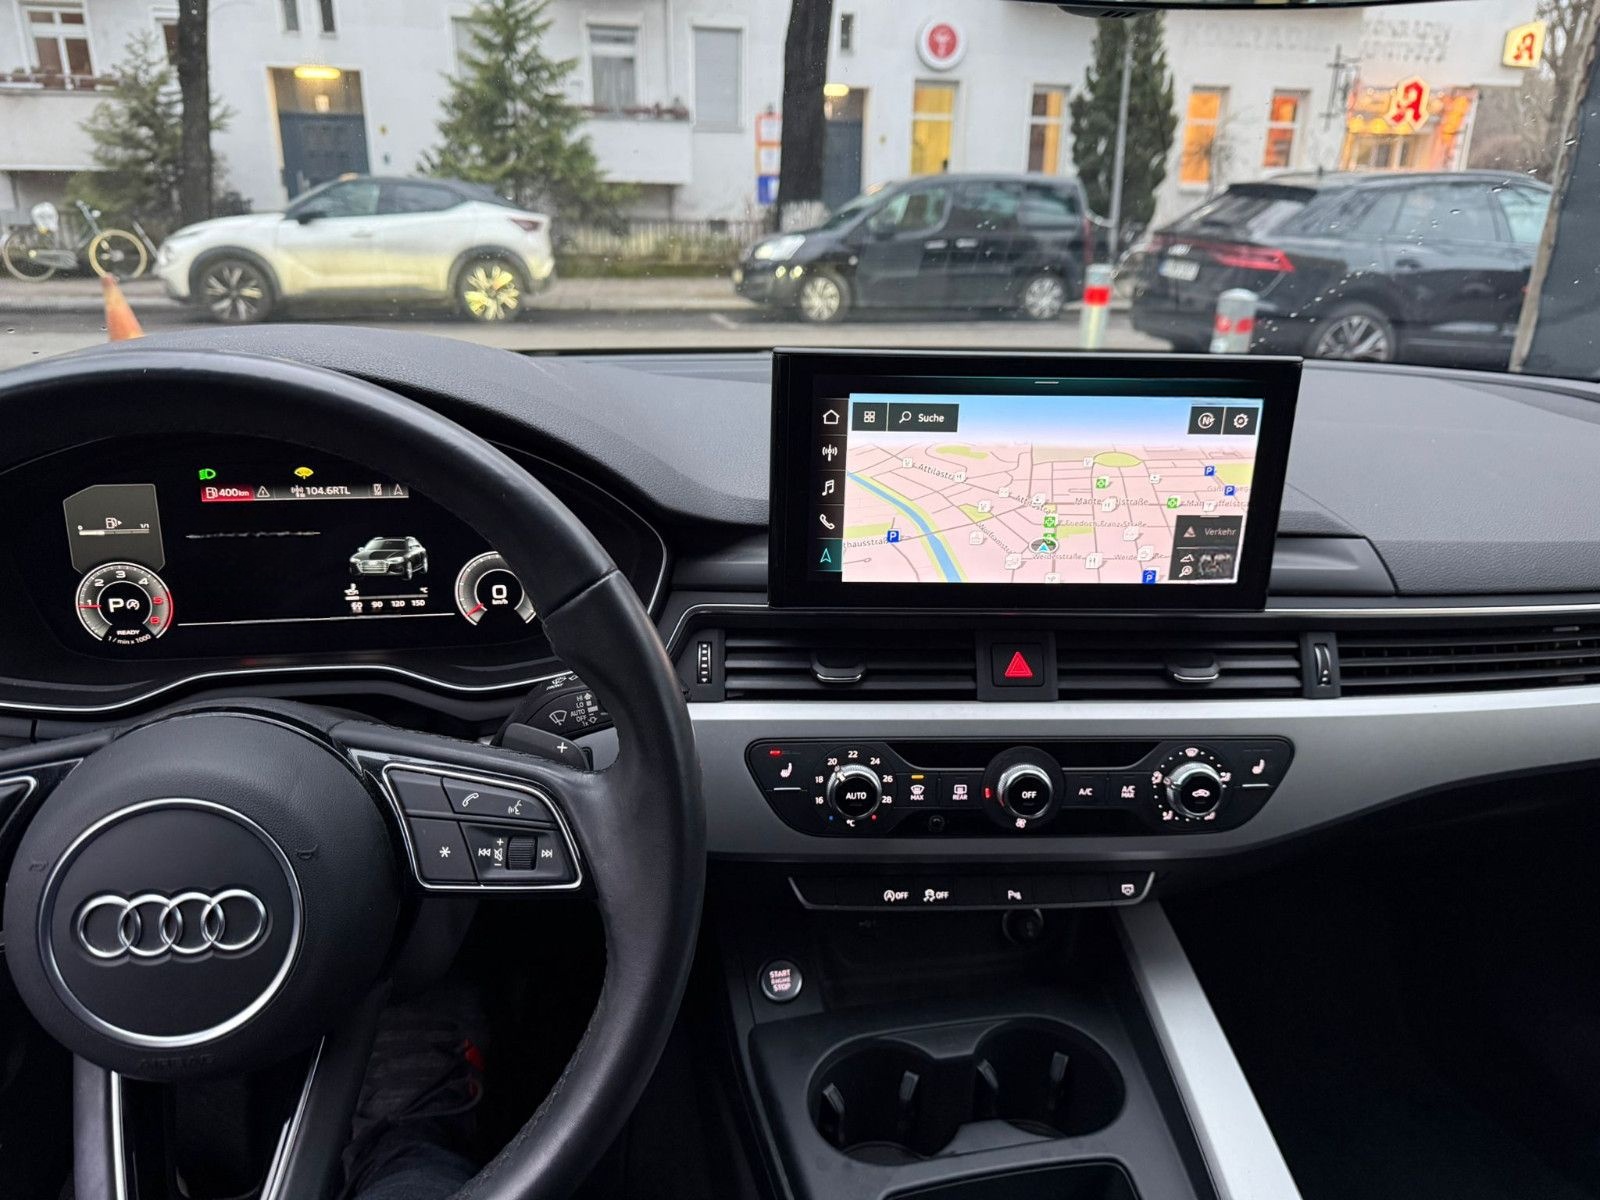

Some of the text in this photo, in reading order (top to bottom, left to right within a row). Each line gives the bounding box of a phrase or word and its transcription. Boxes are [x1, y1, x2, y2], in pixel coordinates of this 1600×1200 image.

[1392, 81, 1424, 122] A
[918, 413, 944, 423] Suche
[1204, 528, 1236, 536] Verkehr
[116, 570, 126, 578] 3
[492, 584, 507, 599] 0
[153, 596, 164, 605] 5
[108, 598, 125, 613] P
[150, 616, 160, 624] 6
[570, 709, 586, 717] AUTO
[846, 792, 867, 800] AUTO
[1022, 791, 1037, 799] OFF
[1079, 788, 1093, 796] A/C
[936, 891, 949, 899] OFF
[769, 969, 791, 979] START
[773, 983, 791, 992] STOP
